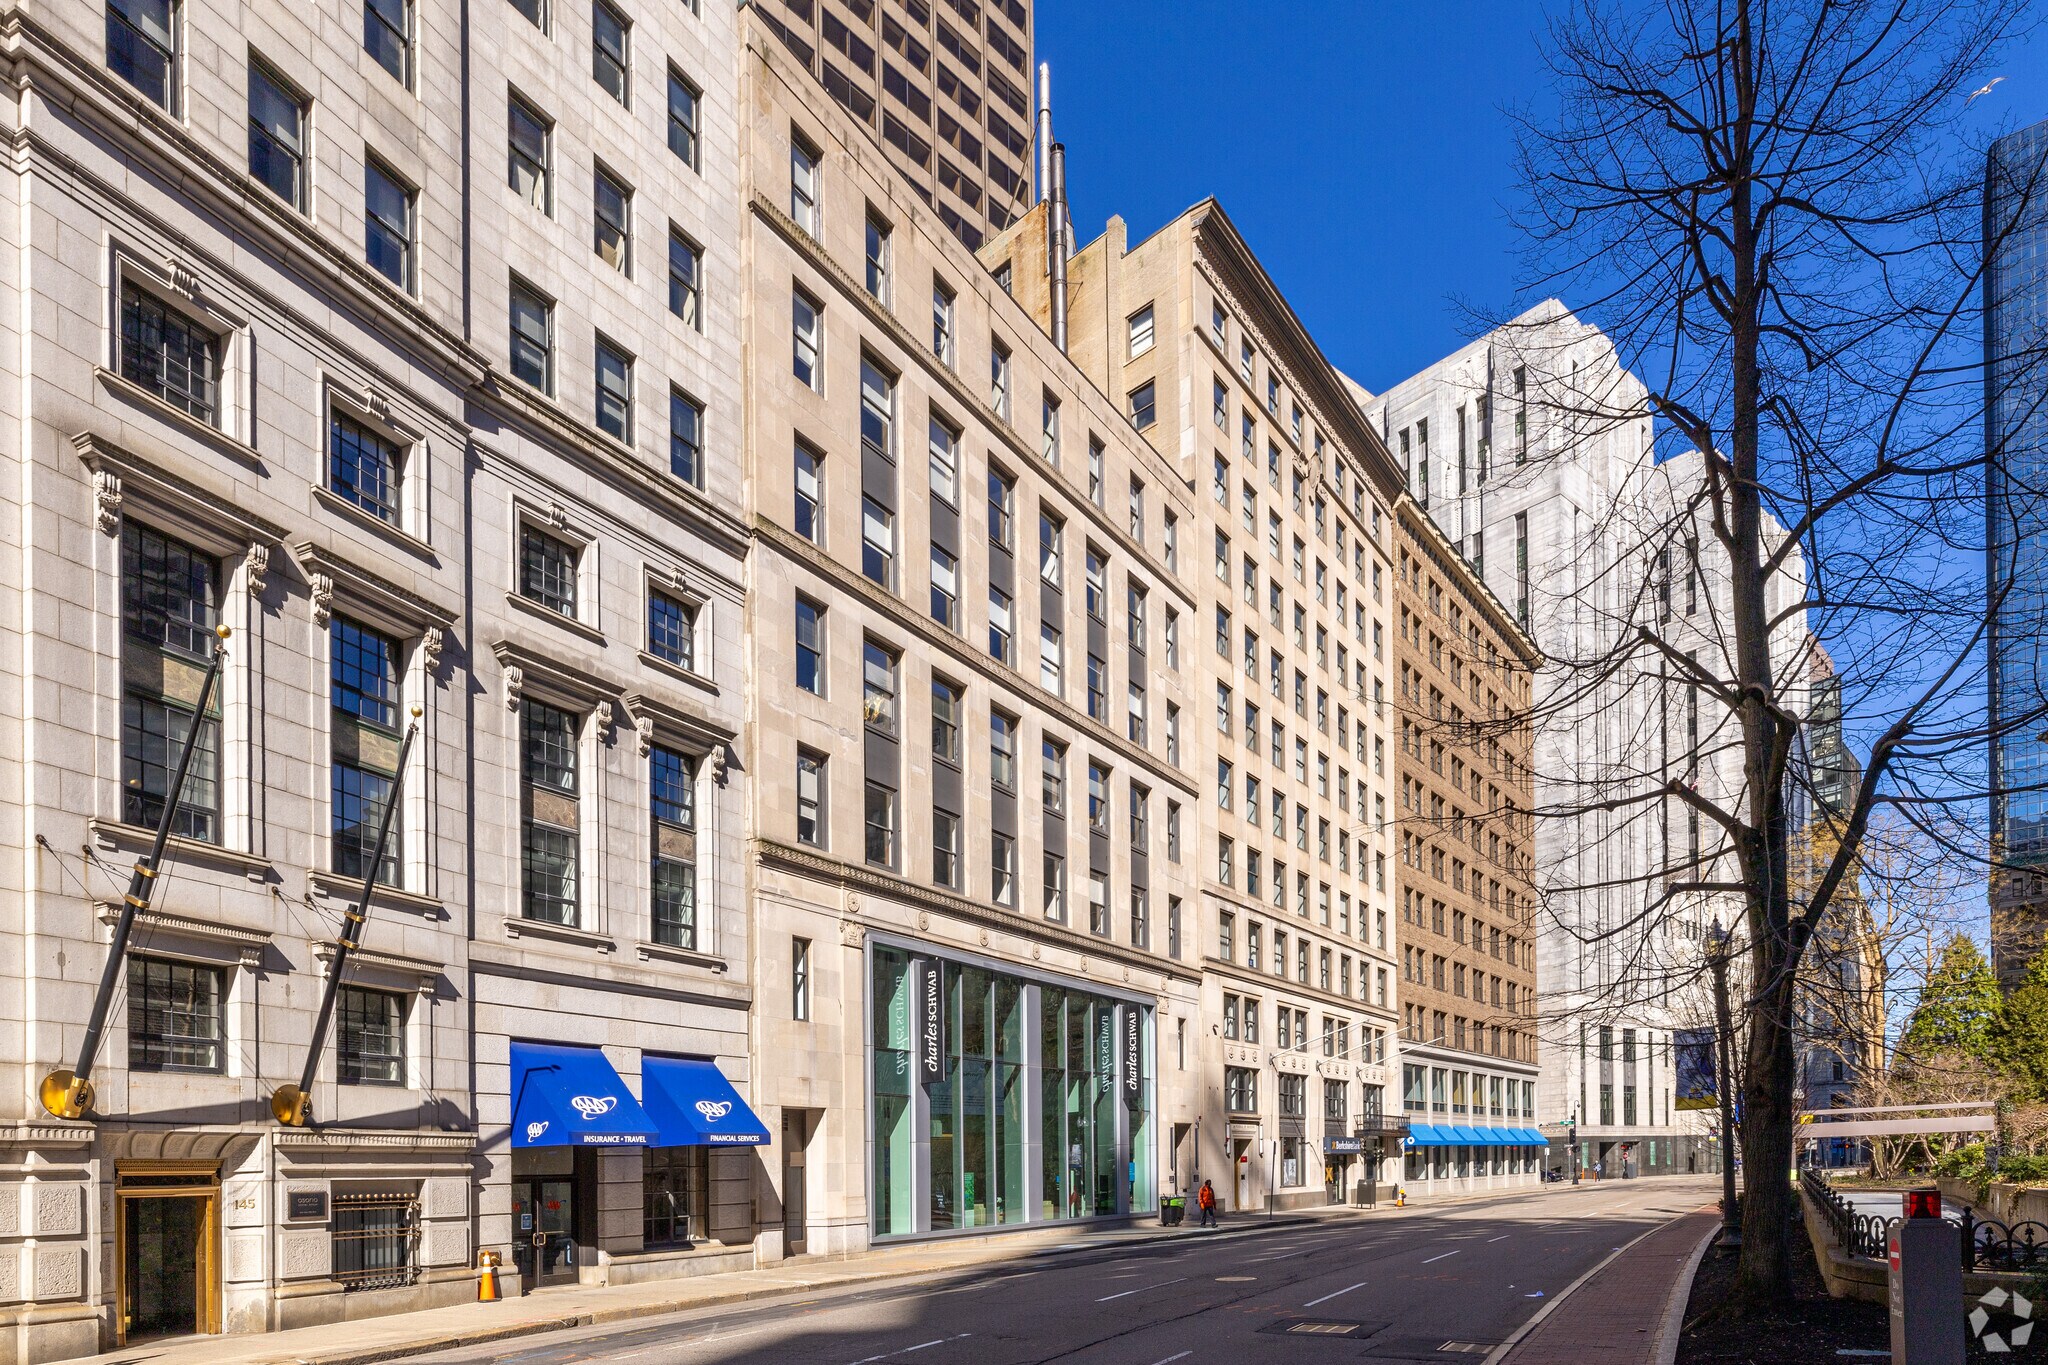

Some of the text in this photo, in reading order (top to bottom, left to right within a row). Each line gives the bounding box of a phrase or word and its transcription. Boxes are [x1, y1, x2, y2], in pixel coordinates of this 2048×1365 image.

[924, 970, 938, 1072] charles SCHWAB
[1126, 1012, 1137, 1091] charles SCHWAB
[571, 1096, 609, 1115] AAA
[695, 1101, 727, 1117] AAA
[583, 1135, 647, 1143] INSURANCE TRAVEL
[234, 1198, 256, 1210] 145
